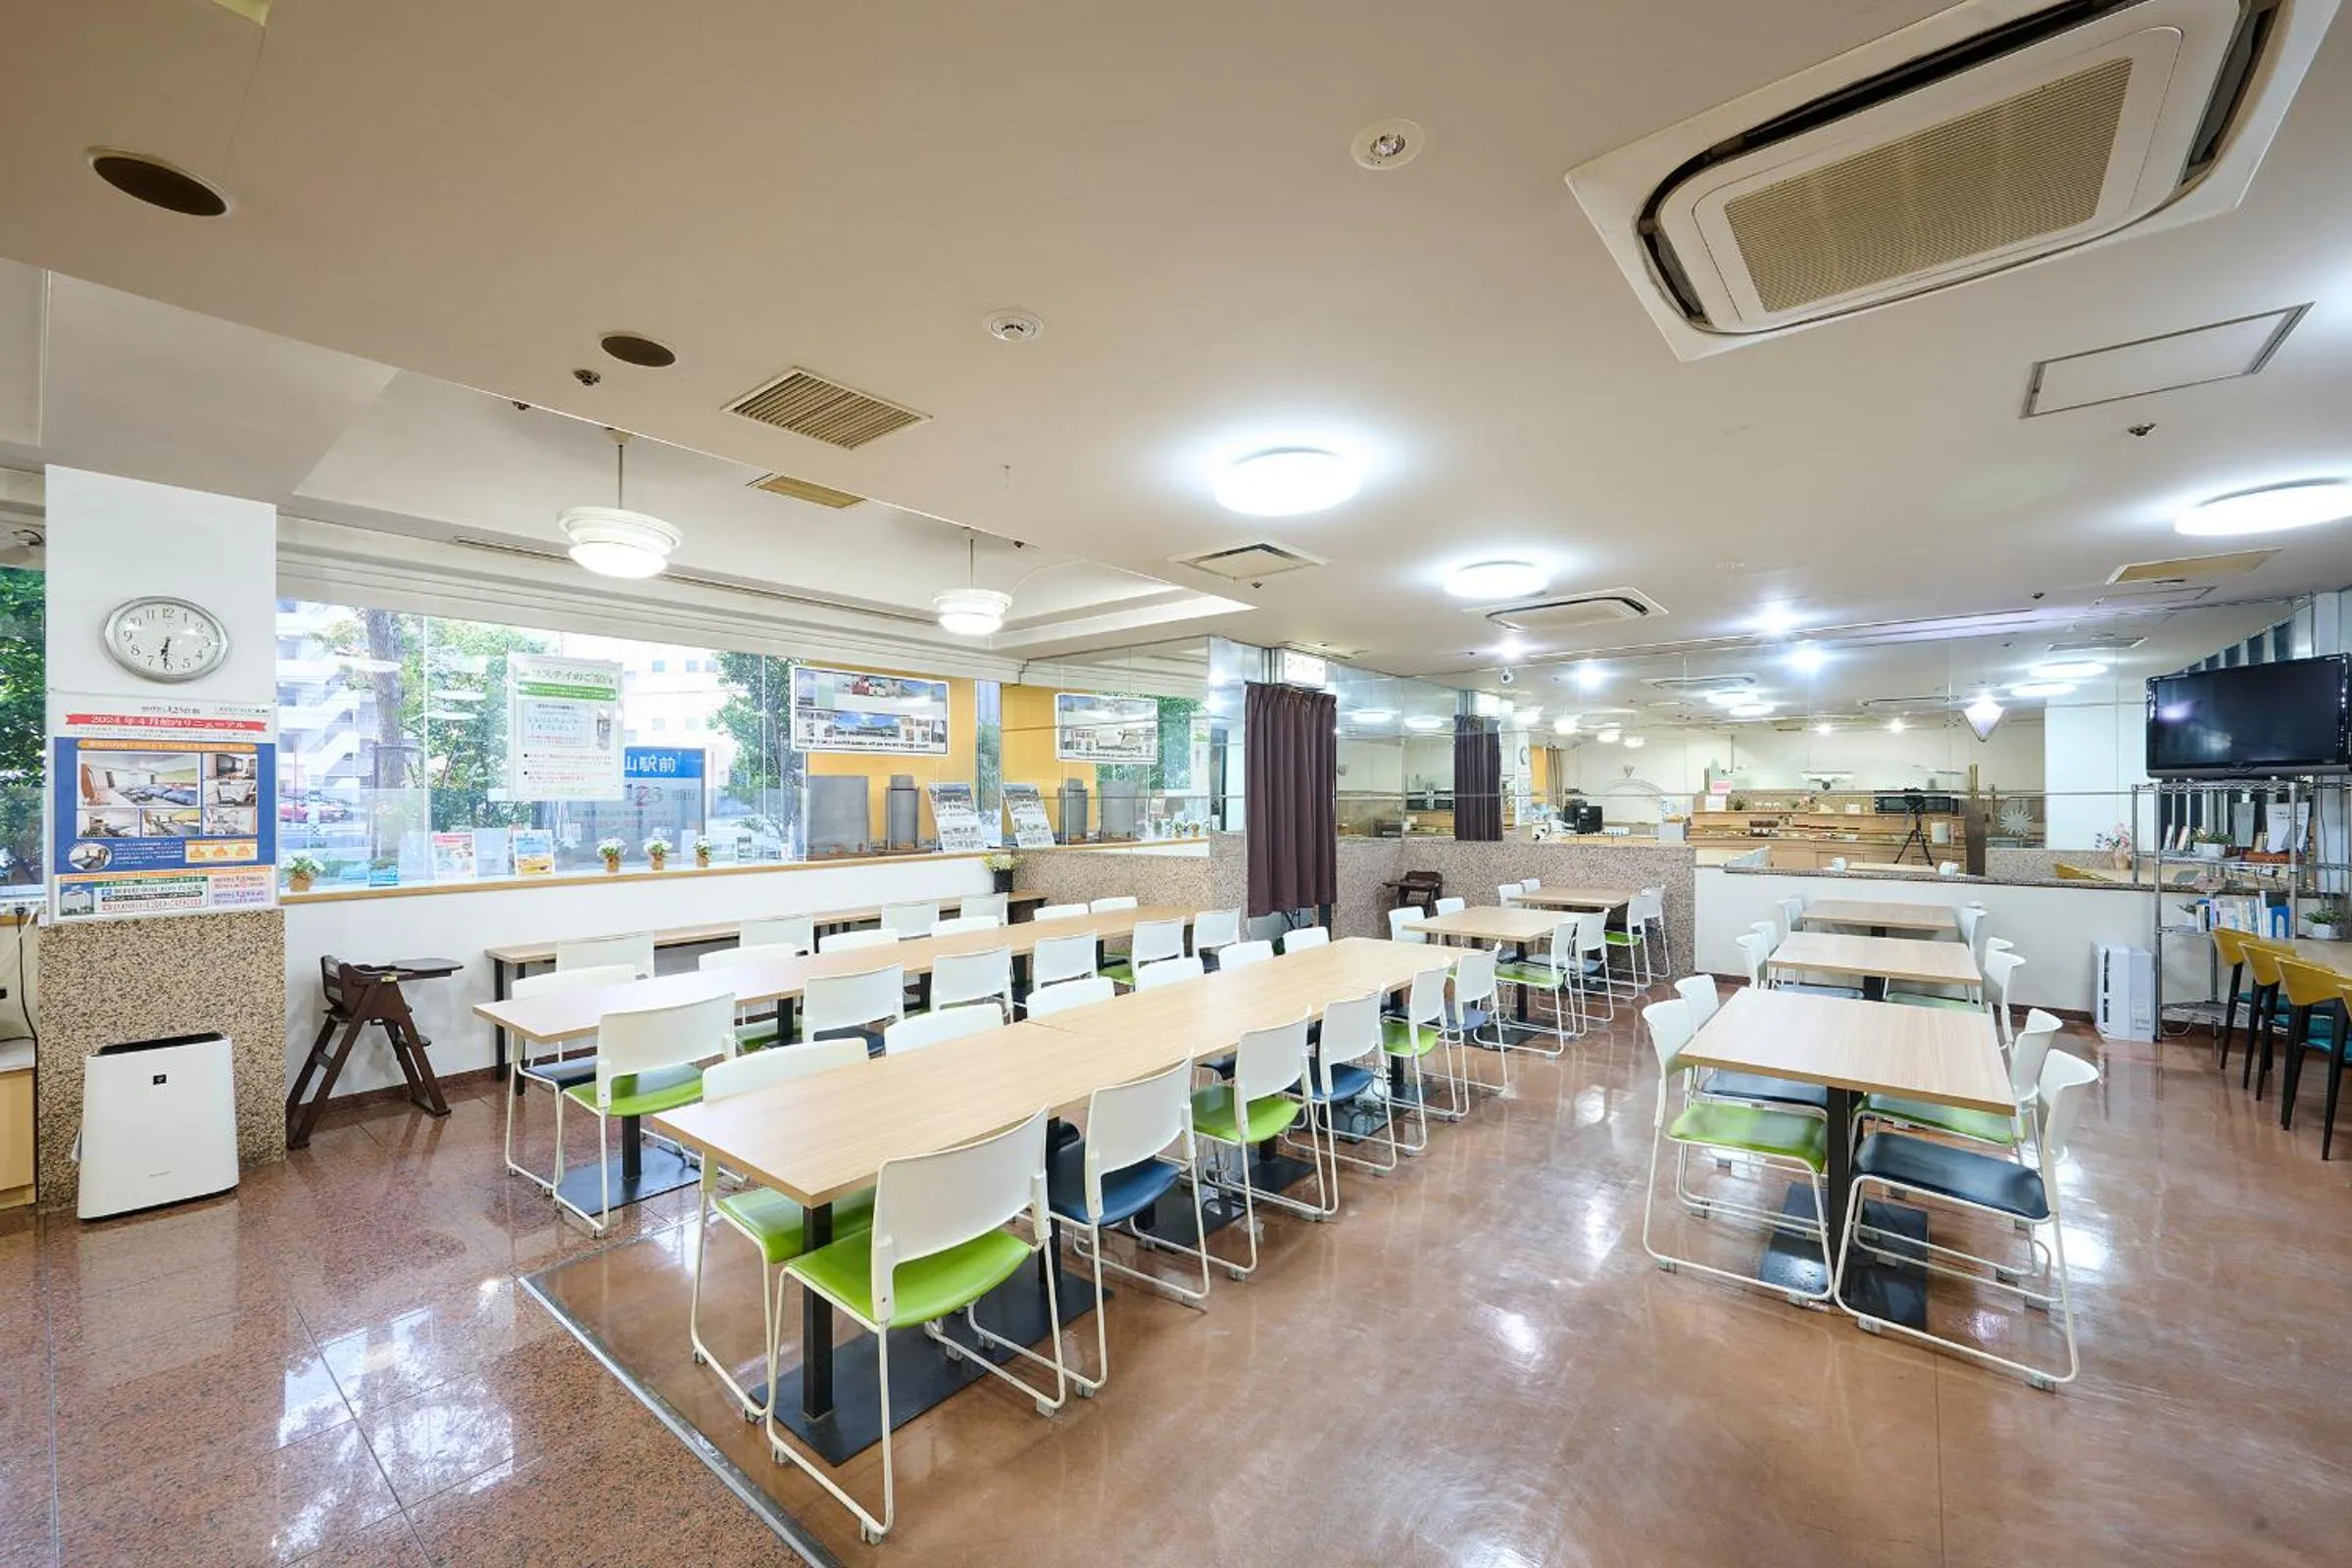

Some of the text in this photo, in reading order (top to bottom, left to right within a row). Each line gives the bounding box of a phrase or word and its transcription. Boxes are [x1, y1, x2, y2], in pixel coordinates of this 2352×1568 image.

[147, 609, 155, 619] 11
[163, 608, 174, 618] 12
[123, 629, 132, 642] 9
[130, 644, 140, 657] 8
[146, 655, 155, 666] 7
[181, 658, 191, 668] 5
